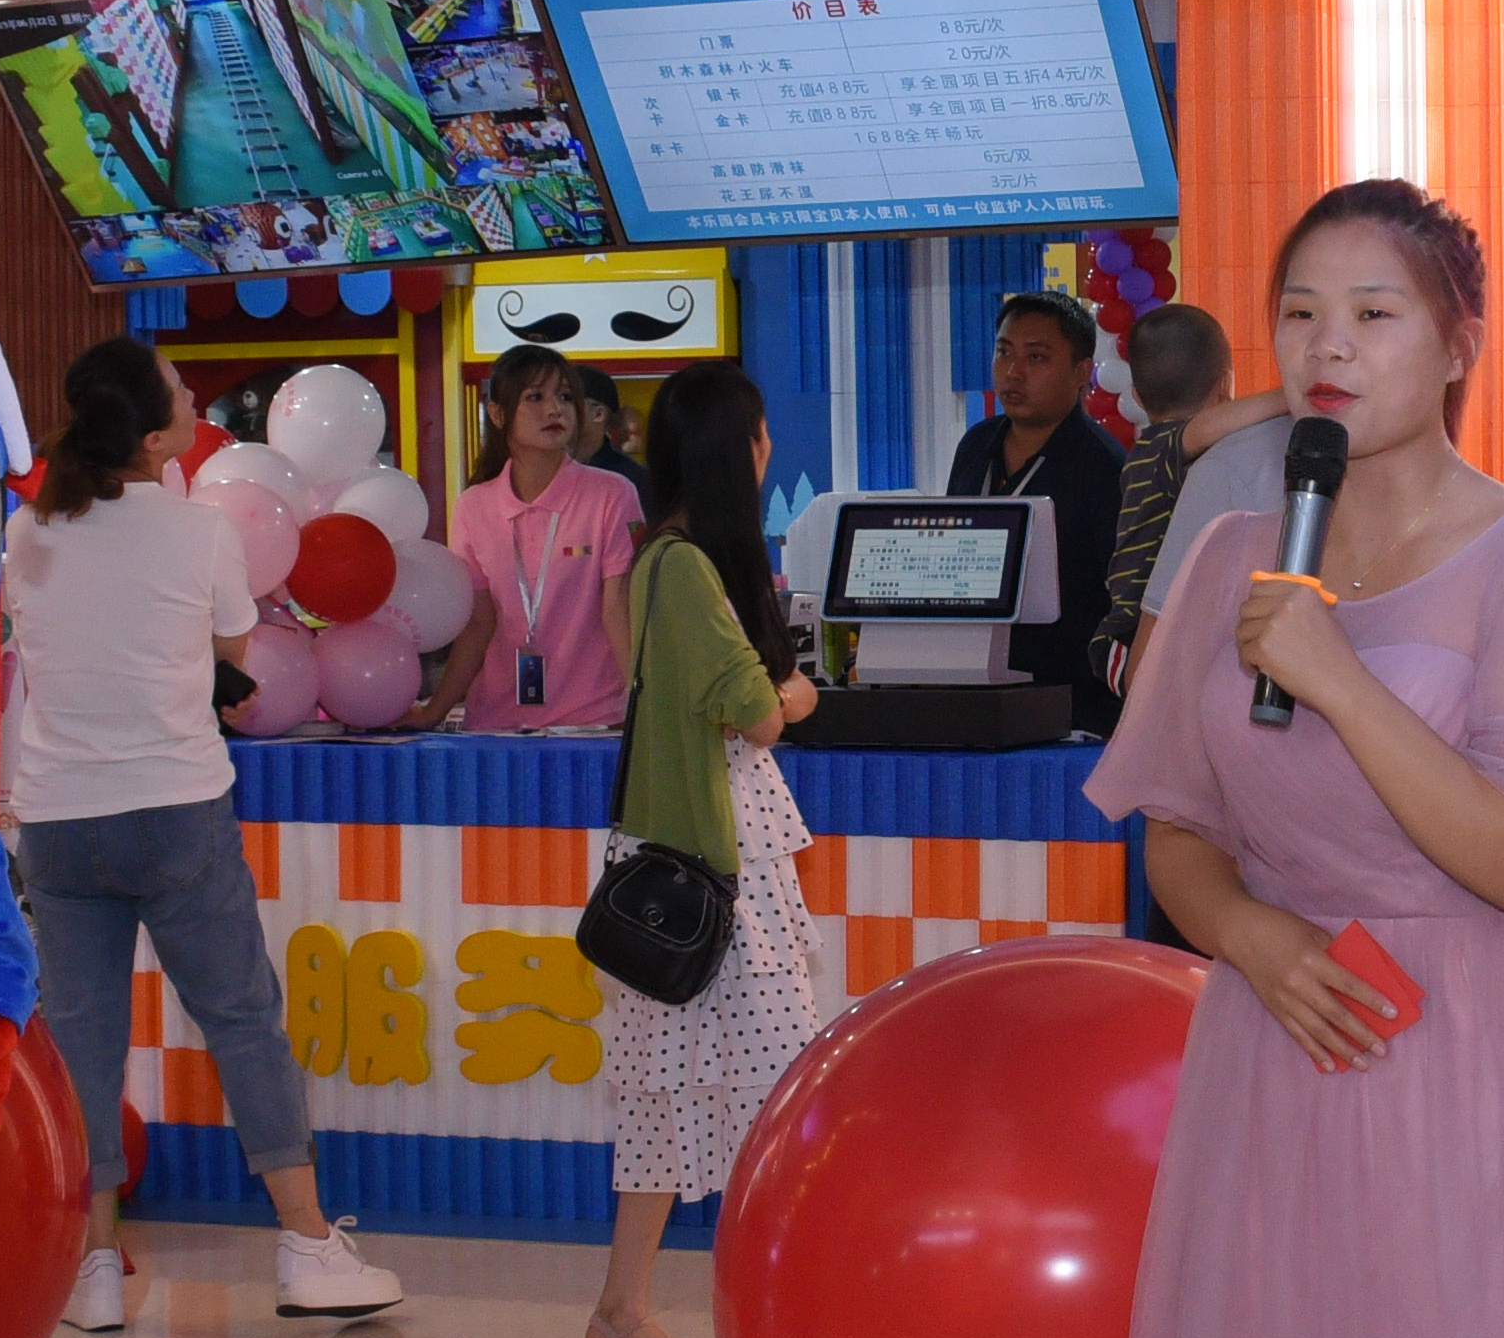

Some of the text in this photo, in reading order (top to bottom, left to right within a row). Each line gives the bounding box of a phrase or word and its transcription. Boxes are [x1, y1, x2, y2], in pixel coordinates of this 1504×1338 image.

[699, 35, 735, 50] 门票
[659, 58, 793, 79] 积木森林小火车
[706, 87, 741, 102] 银卡
[715, 113, 750, 128] 金卡
[854, 125, 984, 144] 1688全年畅玩
[650, 141, 684, 156] 年卡
[983, 148, 1033, 163] 6元/双
[711, 160, 806, 179] 高级防滑袜
[991, 173, 1038, 189] 3元/片
